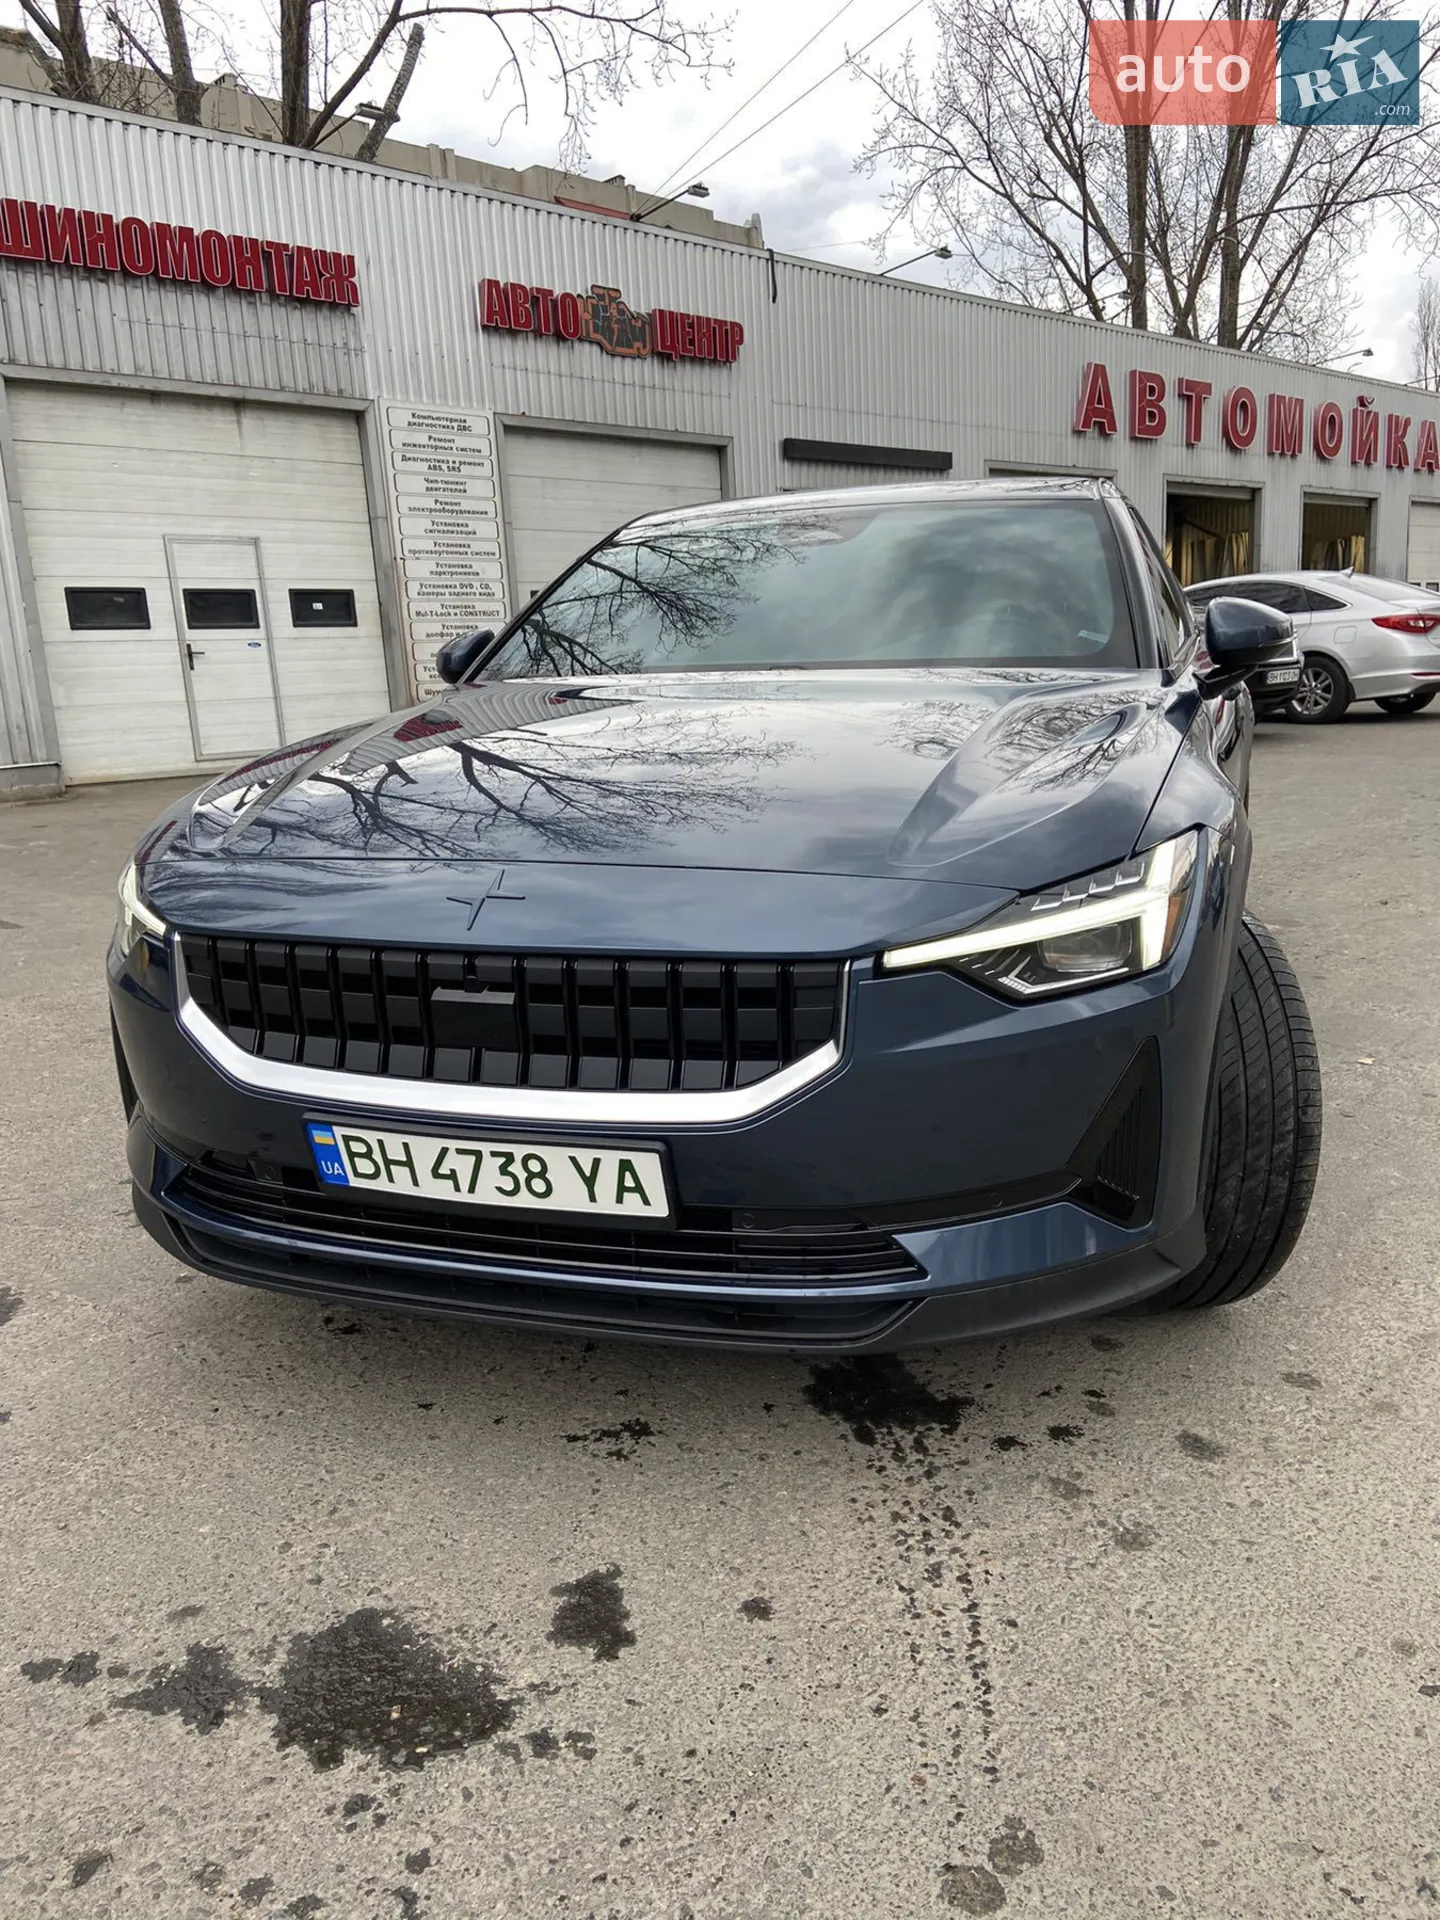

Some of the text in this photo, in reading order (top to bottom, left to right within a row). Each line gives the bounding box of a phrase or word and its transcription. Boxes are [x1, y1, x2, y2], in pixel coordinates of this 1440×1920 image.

[0, 197, 360, 307] ШИНОМОНТАЖ
[479, 278, 744, 363] АВТО ЦЕНТР
[411, 412, 467, 424] Компьютерная
[1074, 361, 1440, 472] АВТОМОЙКА
[407, 421, 472, 432] диагностика ДВС
[428, 435, 455, 444] Ремонт
[401, 442, 454, 452] инжекторных
[401, 454, 450, 464] Диагностика
[427, 464, 461, 473] ABS, SRS
[408, 506, 488, 515] электрооборудования
[431, 520, 469, 528] Установка
[424, 528, 477, 536] сигнализаций
[433, 541, 471, 549] Установка
[419, 582, 457, 590] Установка
[321, 1160, 345, 1176] UA
[341, 1134, 652, 1207] BH 4738 YA
